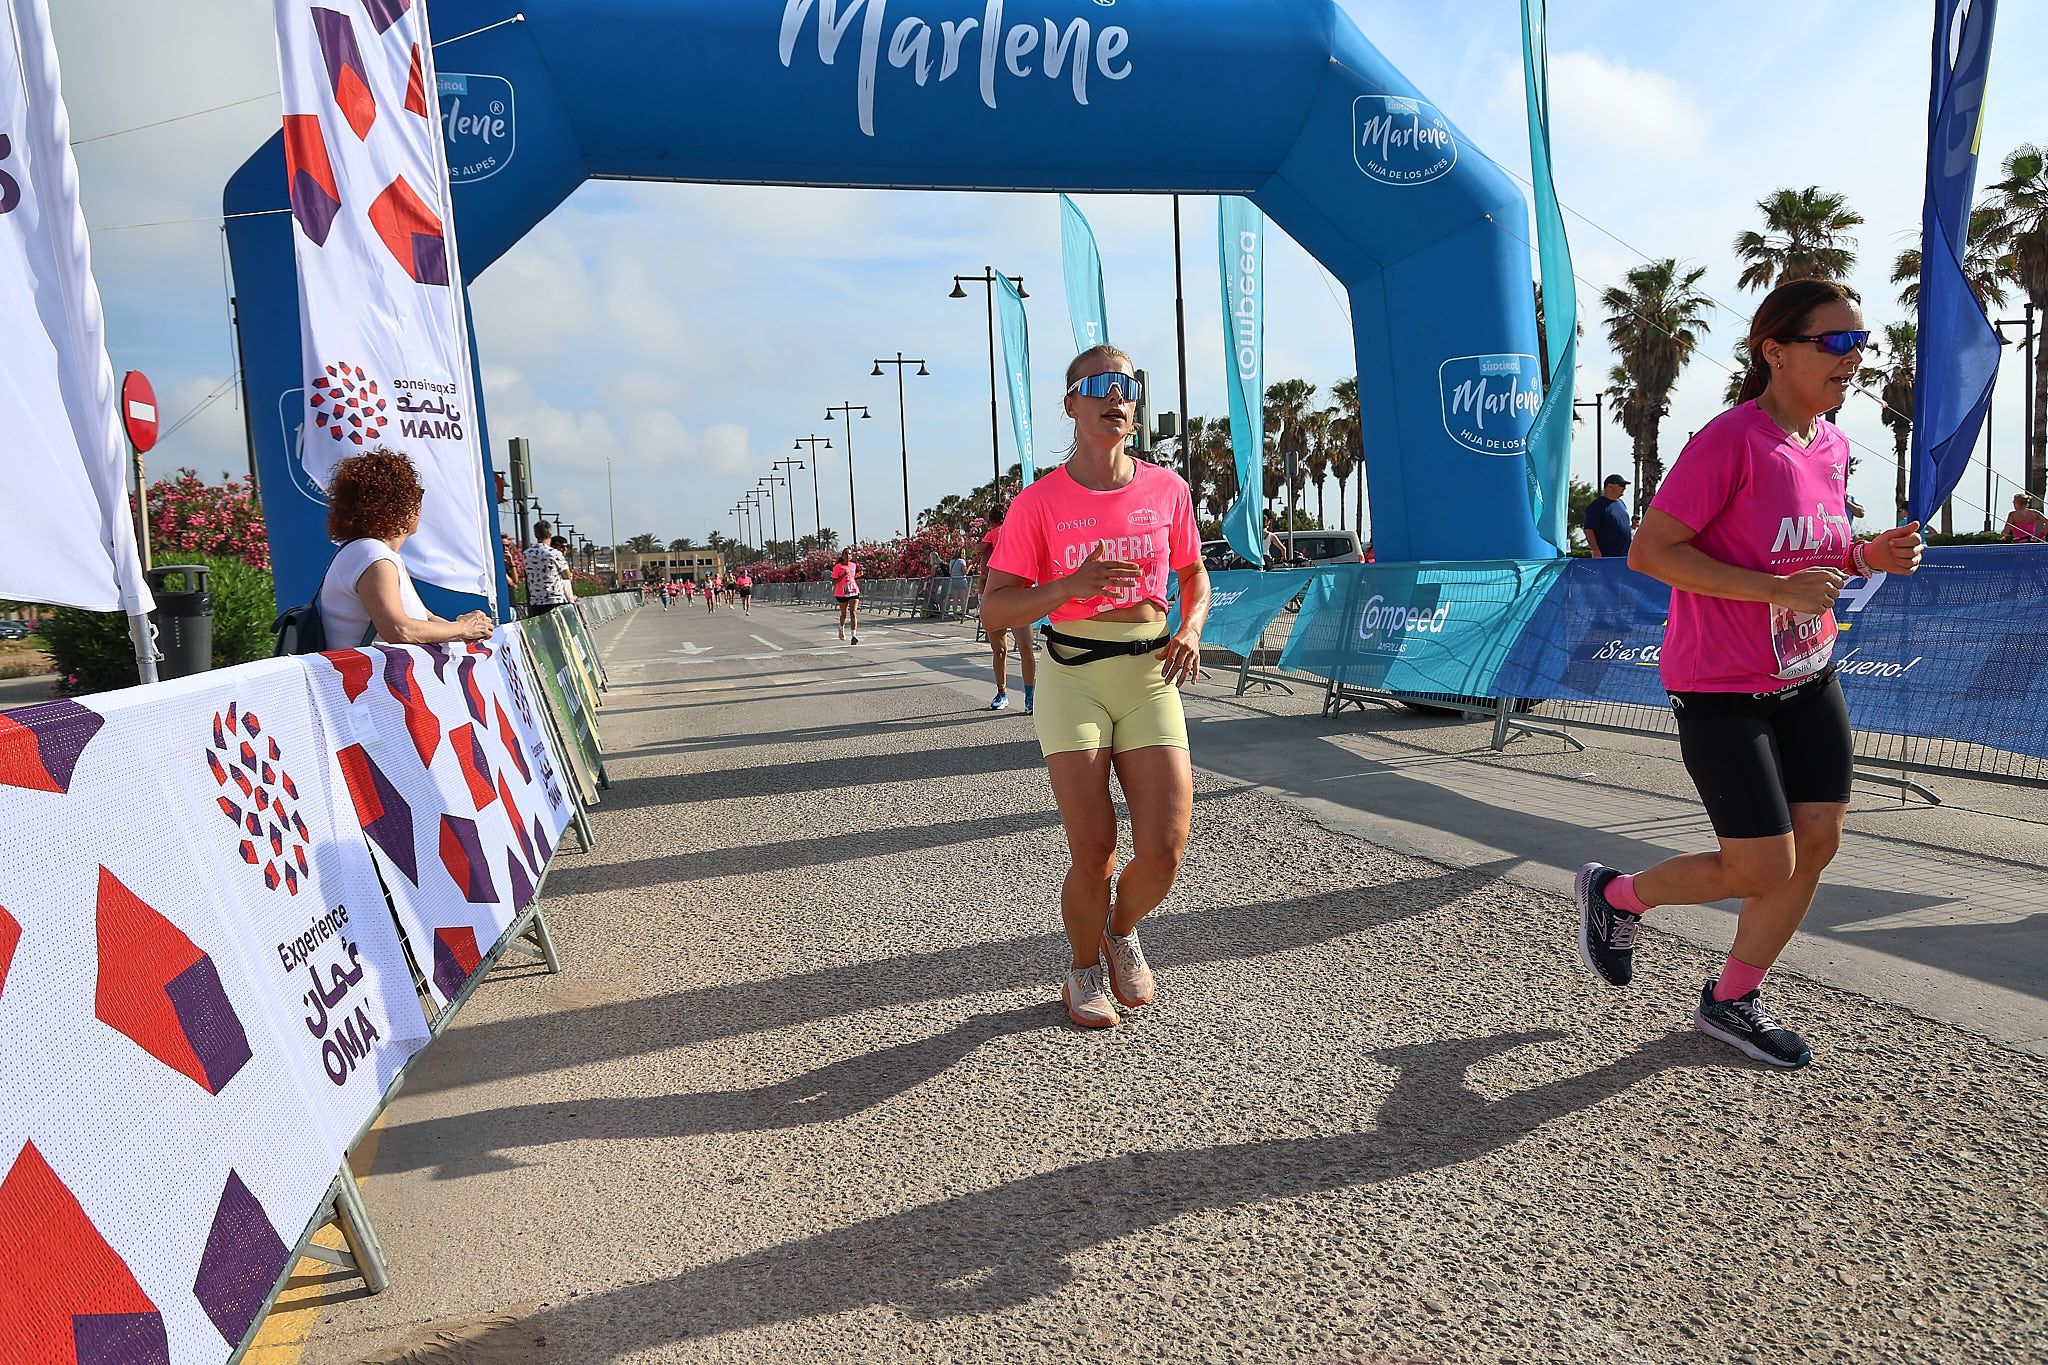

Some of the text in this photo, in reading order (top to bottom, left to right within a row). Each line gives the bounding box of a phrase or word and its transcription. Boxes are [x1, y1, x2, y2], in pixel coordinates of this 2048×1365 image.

[779, 0, 1132, 136] Marlene
[442, 97, 505, 145] lene
[1362, 115, 1449, 161] Marlene
[463, 156, 496, 176] ALPES
[1367, 158, 1448, 179] HIJA DE LOS ALPES
[1453, 376, 1540, 430] Marlene
[1460, 428, 1483, 446] HIJA
[1486, 440, 1500, 449] DE
[1503, 440, 1519, 449] LOS
[1057, 517, 1097, 532] OYSHO
[1360, 594, 1450, 640] Compeed
[1377, 642, 1408, 653] AMPOLLAS
[1835, 647, 1922, 677] bueno!
[278, 904, 349, 973] Experience
[322, 997, 380, 1086] OMA
